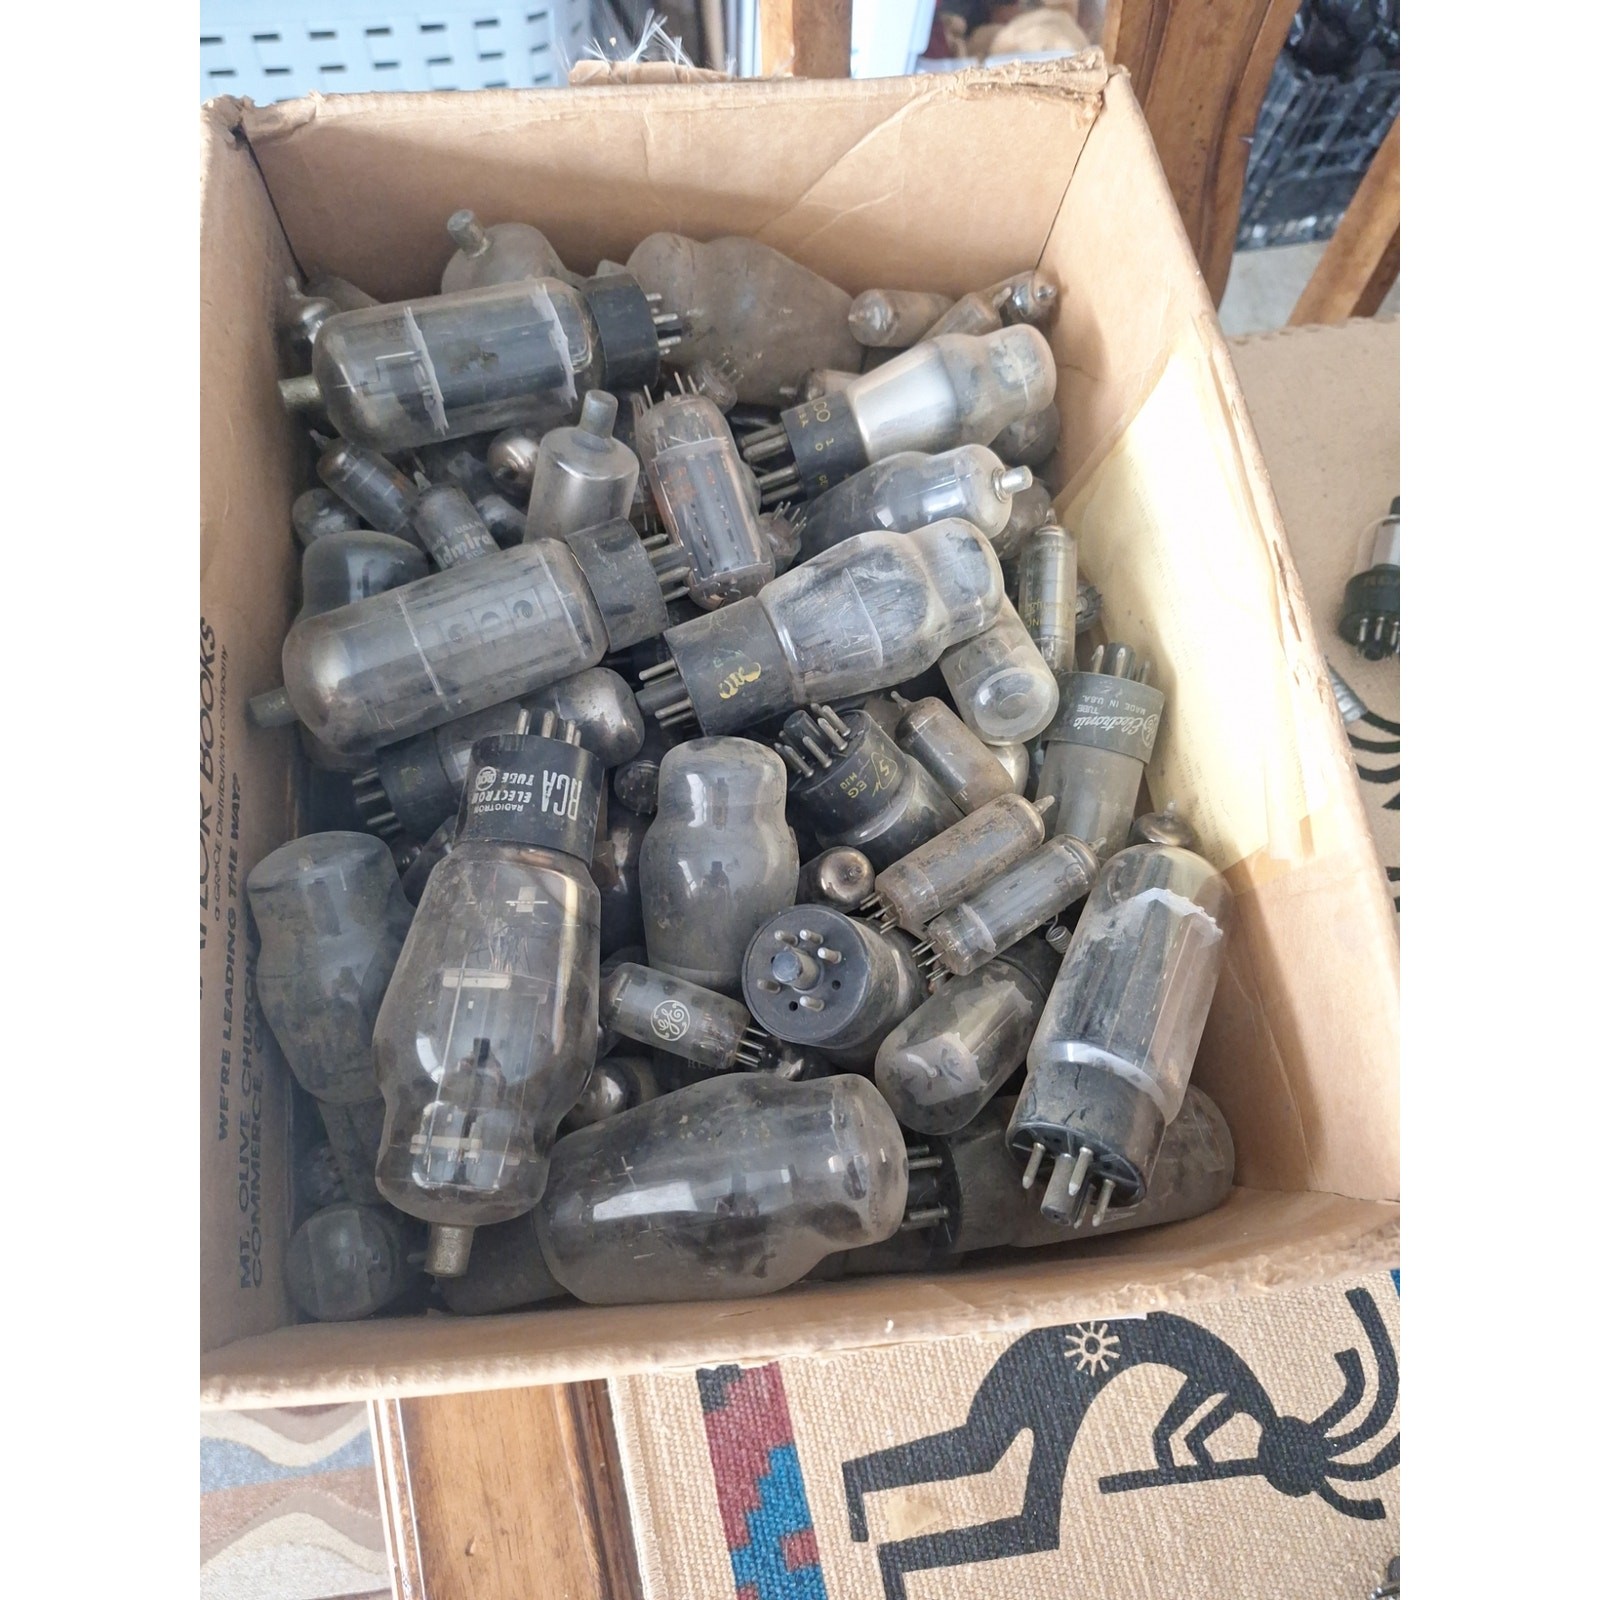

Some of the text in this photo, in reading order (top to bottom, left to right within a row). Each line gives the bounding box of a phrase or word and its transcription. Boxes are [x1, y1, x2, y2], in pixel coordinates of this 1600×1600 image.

[200, 616, 215, 785] BOOKS
[218, 643, 229, 730] company
[1076, 704, 1099, 714] TUBE
[1109, 699, 1120, 708] IN
[1123, 702, 1146, 715] MADE
[1073, 715, 1144, 735] Electronic
[214, 734, 227, 838] Distribution
[501, 772, 535, 786] TUBE
[541, 770, 583, 821] RCA
[847, 781, 868, 798] EG
[473, 803, 524, 814] RADIOTRON
[227, 845, 238, 899] THE
[222, 907, 237, 1041] LEADING
[218, 1047, 231, 1141] WE'RE
[239, 1110, 249, 1214] OLIVE
[239, 1230, 251, 1289] MT.
